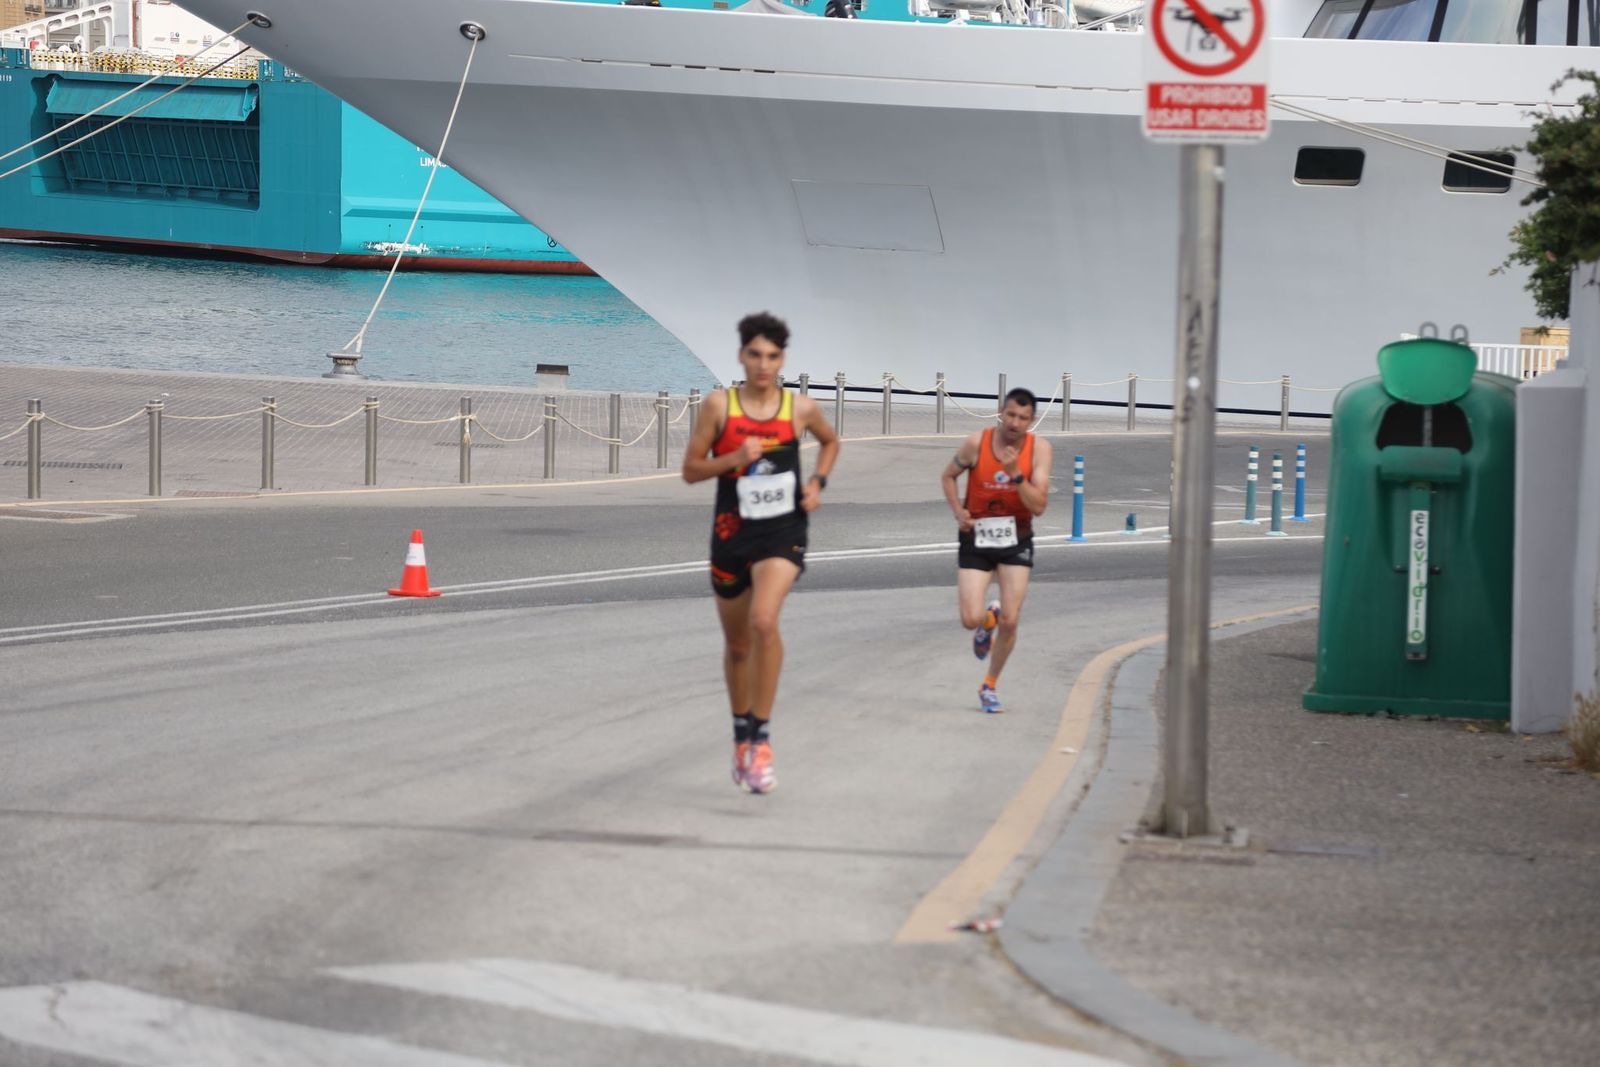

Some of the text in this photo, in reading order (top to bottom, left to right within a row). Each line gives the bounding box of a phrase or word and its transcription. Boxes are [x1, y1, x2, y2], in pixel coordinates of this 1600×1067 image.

[1160, 85, 1253, 106] PROHIBIDO
[1196, 108, 1265, 129] DRONES
[750, 488, 784, 504] 368
[979, 527, 1012, 538] 1128
[1410, 512, 1426, 641] ecovidrio
